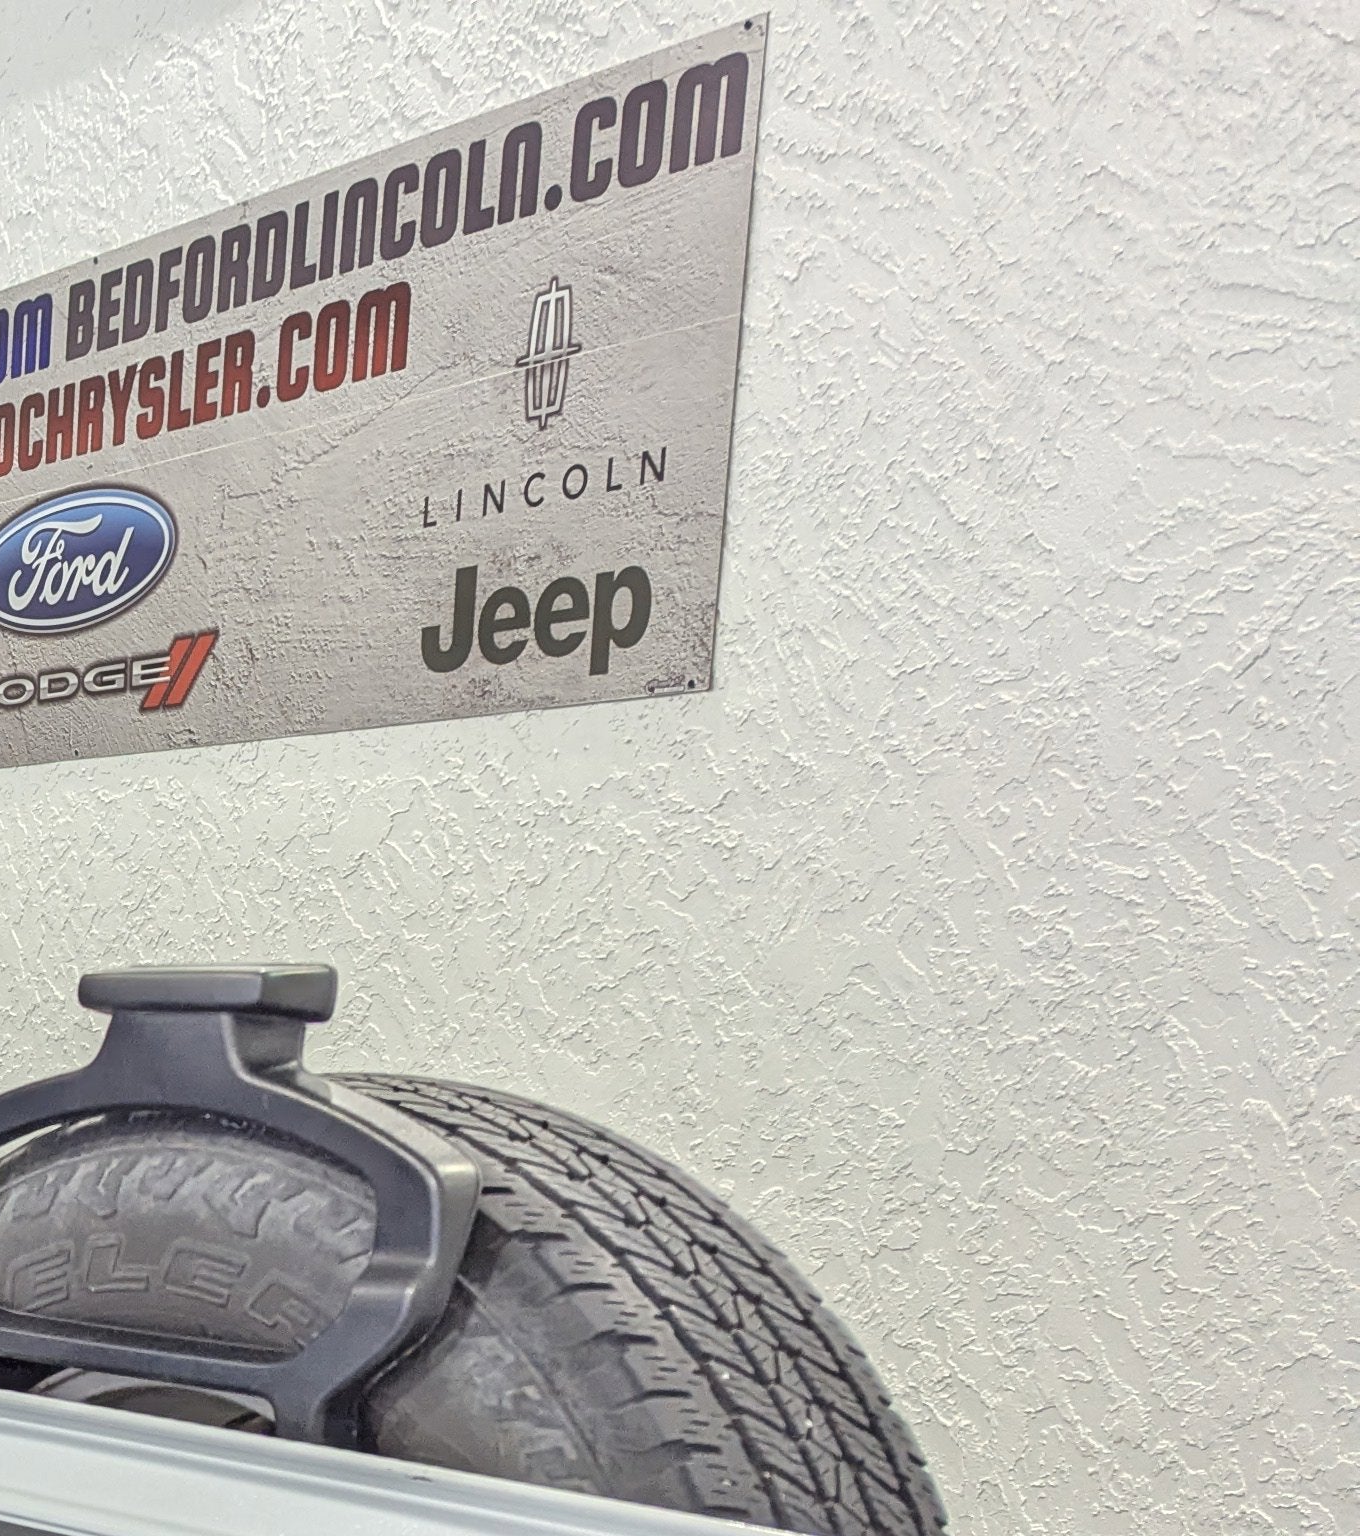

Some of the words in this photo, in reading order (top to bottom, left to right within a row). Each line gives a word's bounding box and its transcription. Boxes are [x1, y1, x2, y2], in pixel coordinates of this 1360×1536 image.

[66, 51, 749, 362] BEDFORDLINCOLN.COM
[423, 446, 667, 528] LINCOLN
[8, 513, 136, 611] Ford
[421, 564, 652, 676] Jeep
